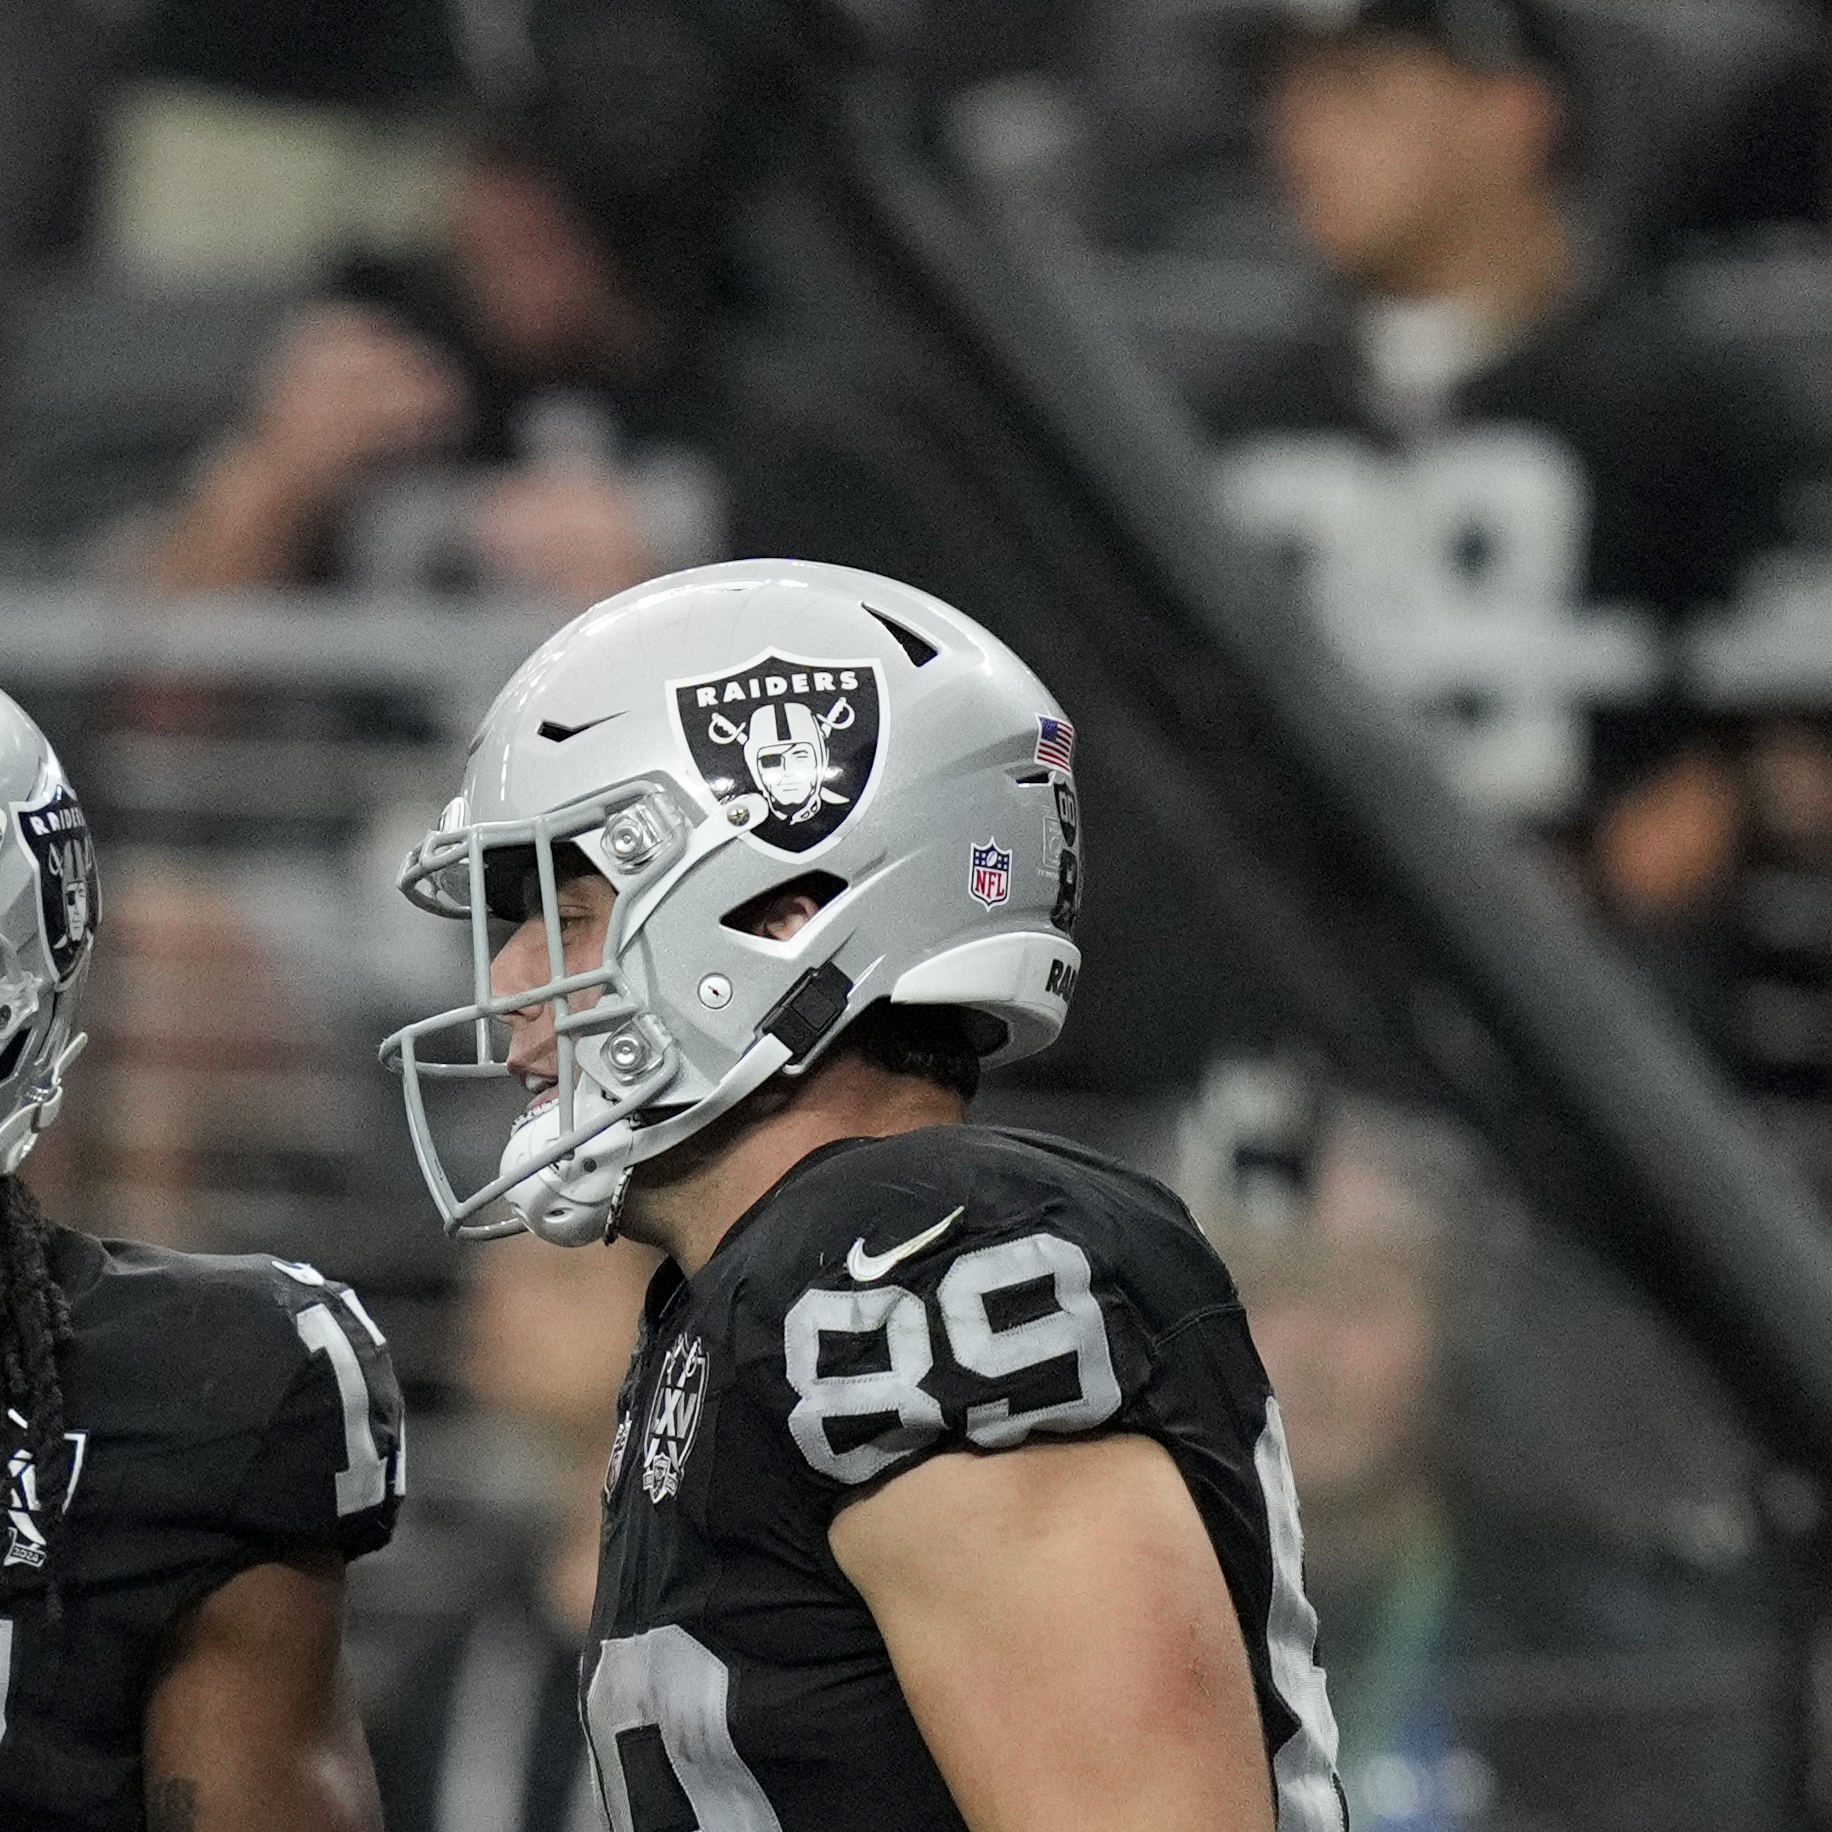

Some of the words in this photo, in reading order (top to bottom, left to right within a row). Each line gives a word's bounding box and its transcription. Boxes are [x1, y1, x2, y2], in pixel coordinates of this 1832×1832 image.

[696, 670, 859, 708] RAIDERS
[974, 868, 1006, 900] NFL
[783, 1233, 1123, 1485] 89
